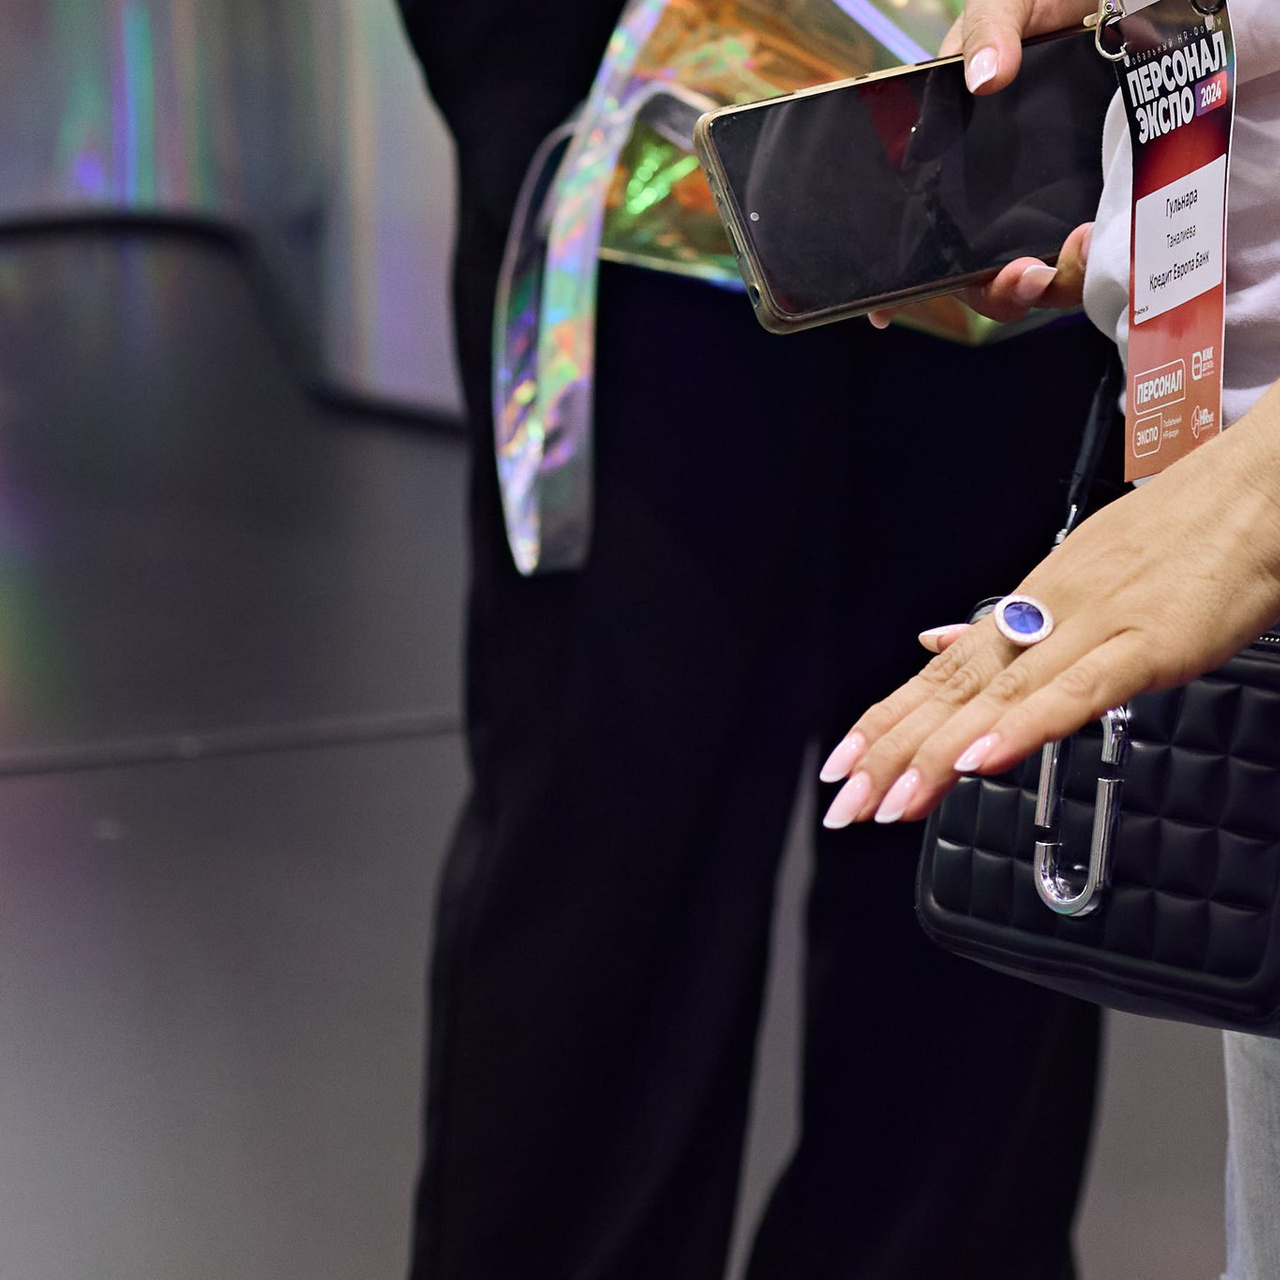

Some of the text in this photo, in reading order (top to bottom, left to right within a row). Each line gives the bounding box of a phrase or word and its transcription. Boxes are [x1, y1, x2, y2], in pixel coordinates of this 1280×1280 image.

[1126, 30, 1228, 108] ПЕРСОНАЛ
[1131, 37, 1174, 66] обальный
[1135, 80, 1223, 144] ЭКСПО 2024
[1165, 188, 1198, 219] Гульнара
[1149, 250, 1211, 293] Кредит Европа Банк
[1136, 369, 1183, 405] ПЕРСОНАЛ
[1136, 426, 1159, 447] ЭКСПО
